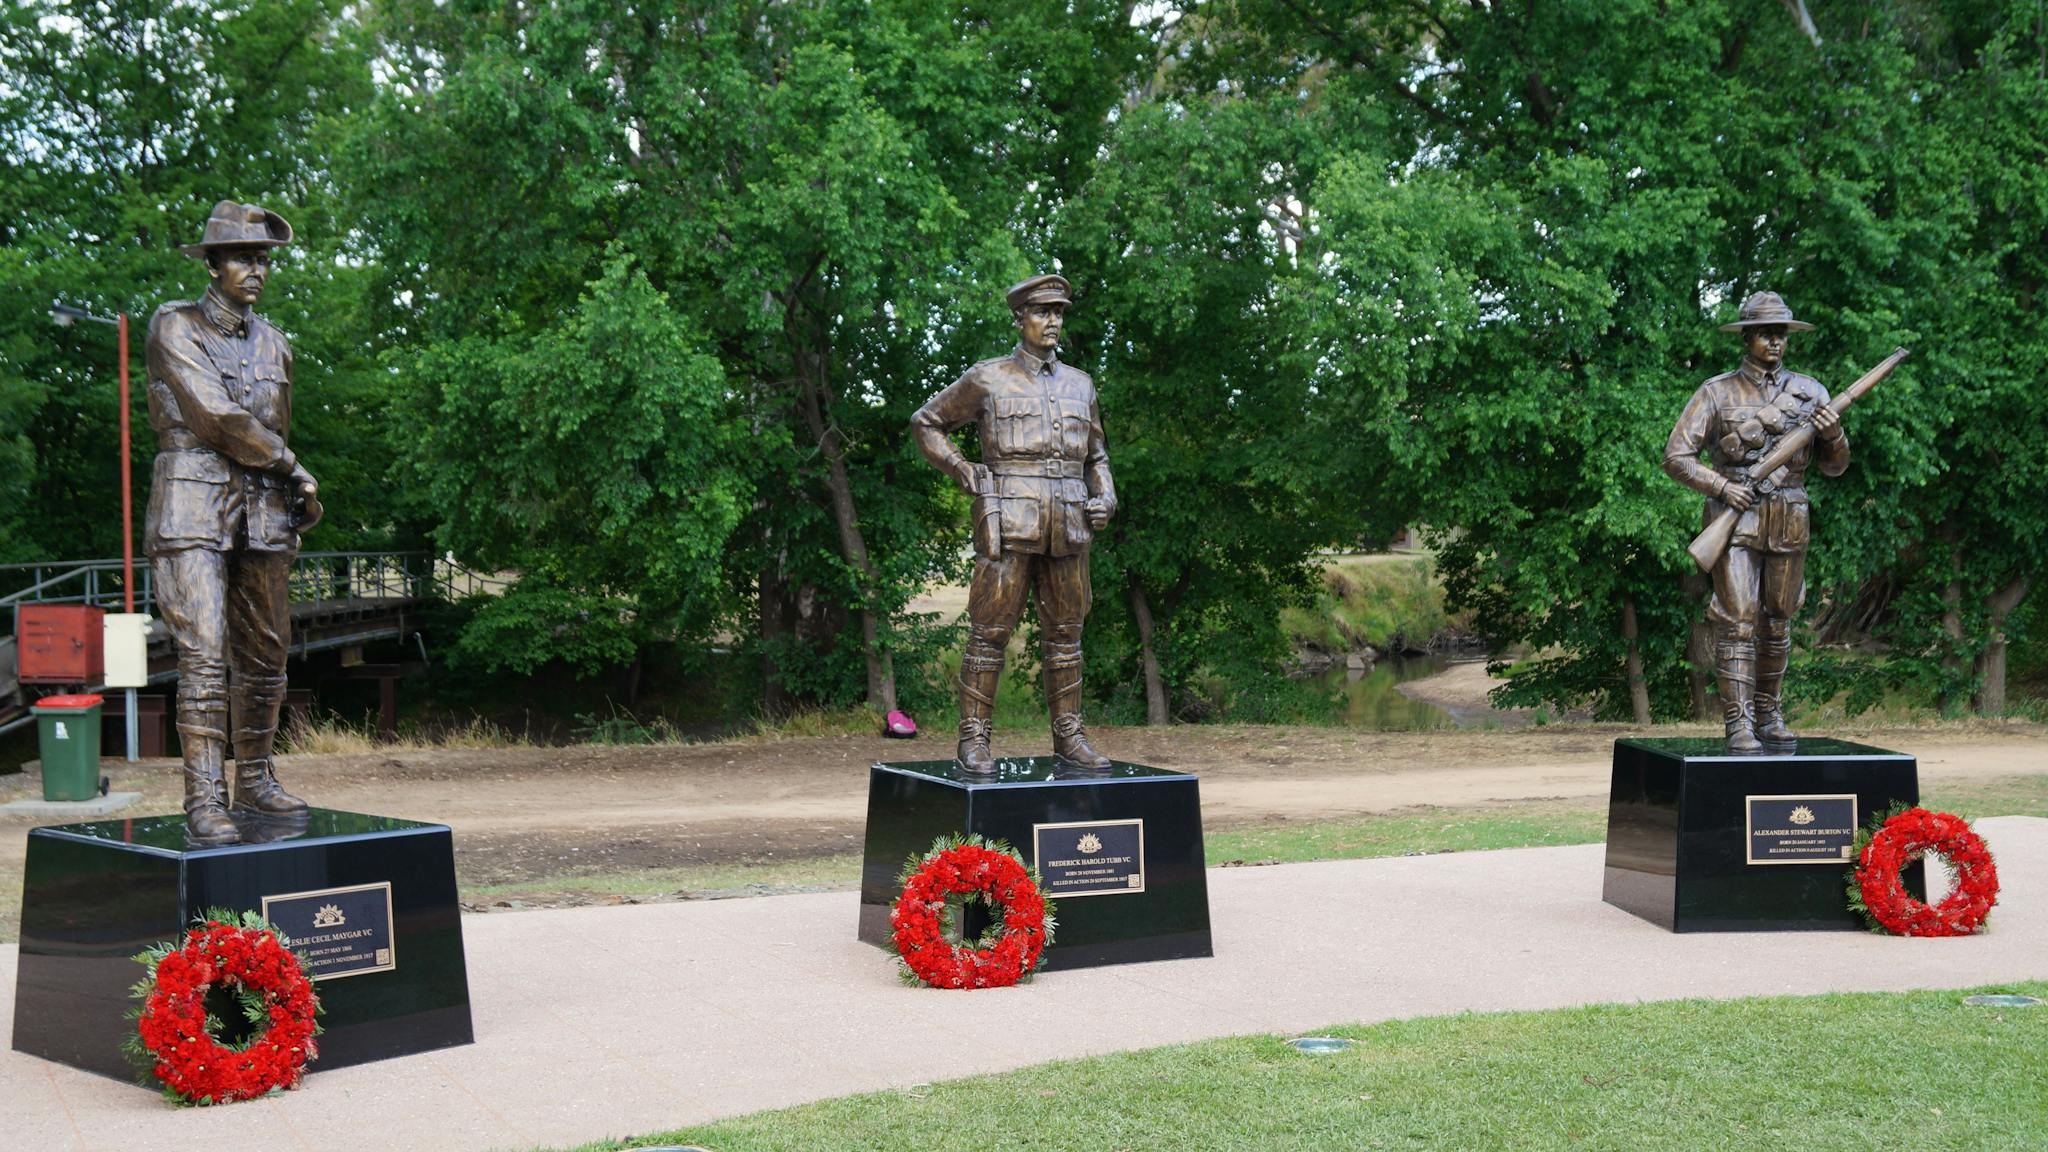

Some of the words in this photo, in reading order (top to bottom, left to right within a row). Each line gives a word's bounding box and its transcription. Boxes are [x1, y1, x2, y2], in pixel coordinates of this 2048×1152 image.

[1048, 860, 1080, 868] FREDERICK
[1081, 858, 1106, 866] HAROLD
[311, 934, 333, 944] CECIL
[332, 930, 361, 941] MAYGAR
[362, 928, 373, 937] VC
[314, 959, 332, 967] ACTION
[336, 954, 363, 962] NOVEMBER
